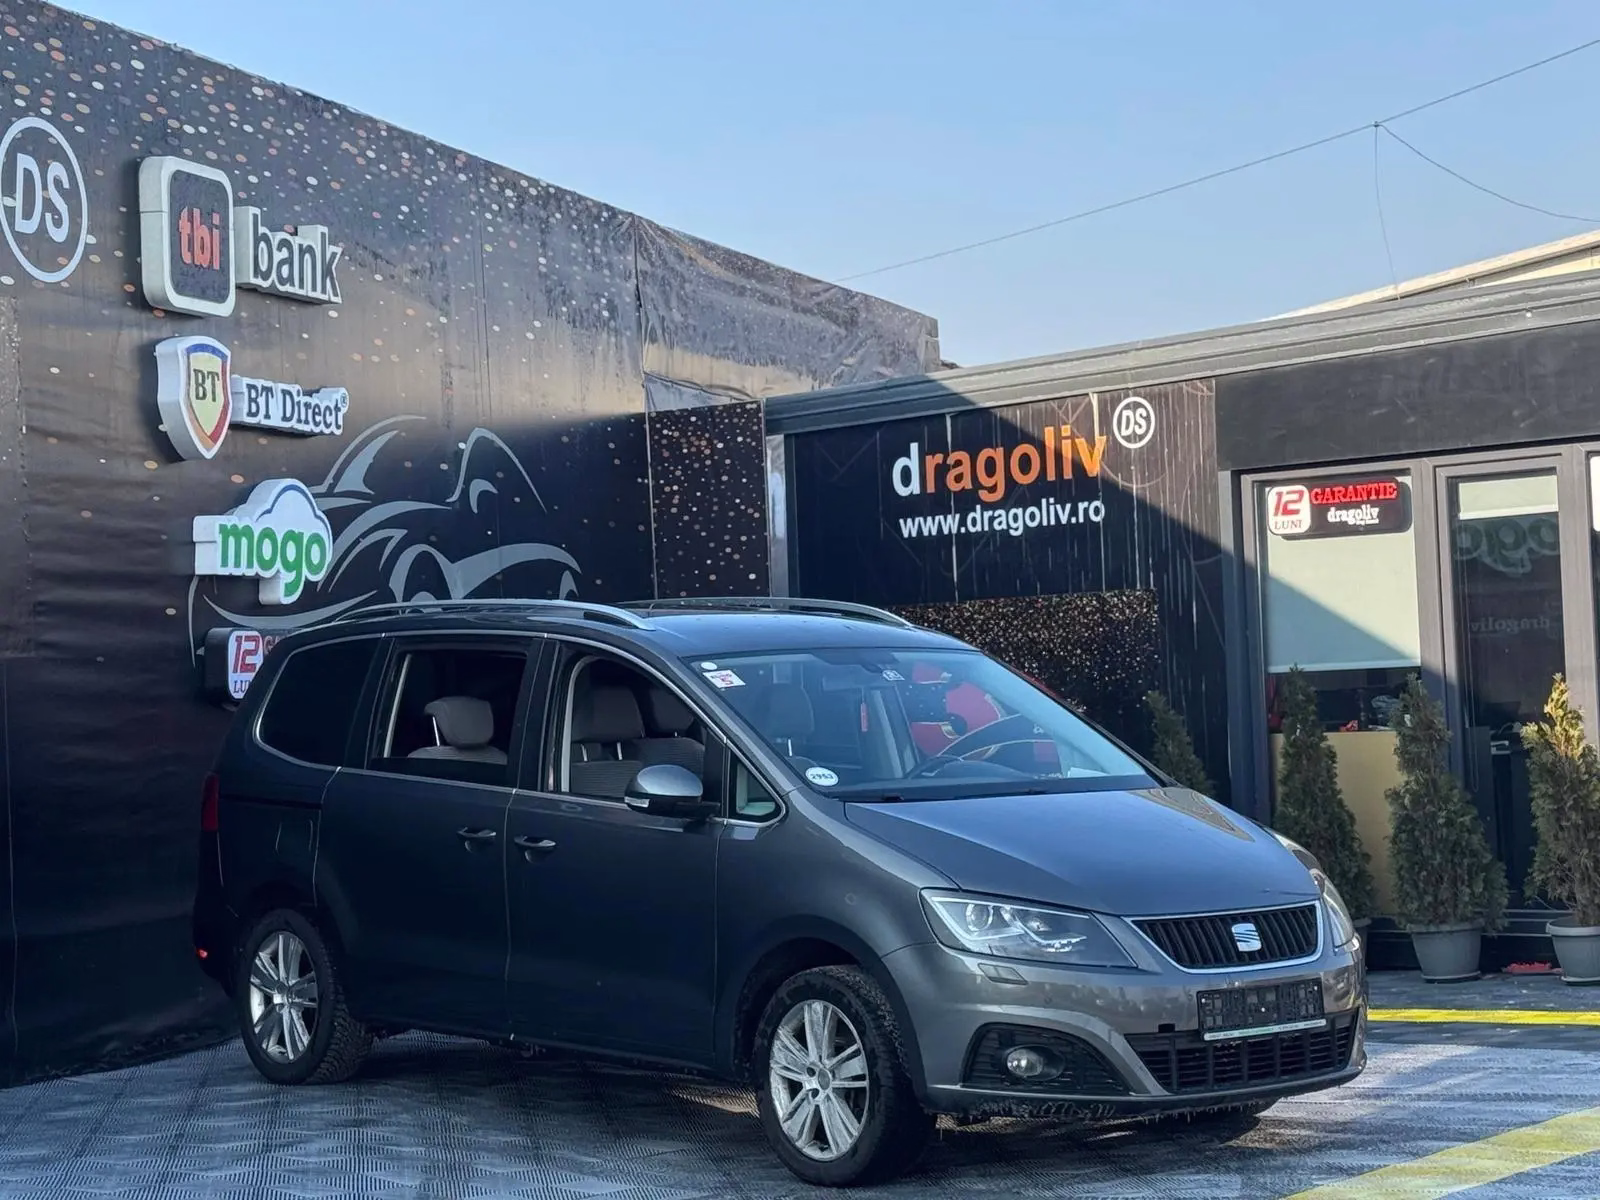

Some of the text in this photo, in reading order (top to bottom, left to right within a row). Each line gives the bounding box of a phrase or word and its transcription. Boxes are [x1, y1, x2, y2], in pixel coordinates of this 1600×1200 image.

[15, 152, 70, 243] DS
[179, 205, 341, 302] tbi bank
[193, 368, 220, 402] BT
[246, 383, 273, 420] BT
[1120, 408, 1147, 436] DS
[892, 425, 1107, 502] dragoliv
[1273, 490, 1305, 516] 12
[1311, 482, 1398, 504] GARANTIE
[899, 498, 1105, 538] www.dragoliv.ro
[1274, 519, 1303, 530] LUNI
[219, 523, 327, 597] mogo
[232, 635, 261, 673] 12
[233, 680, 250, 693] LU
